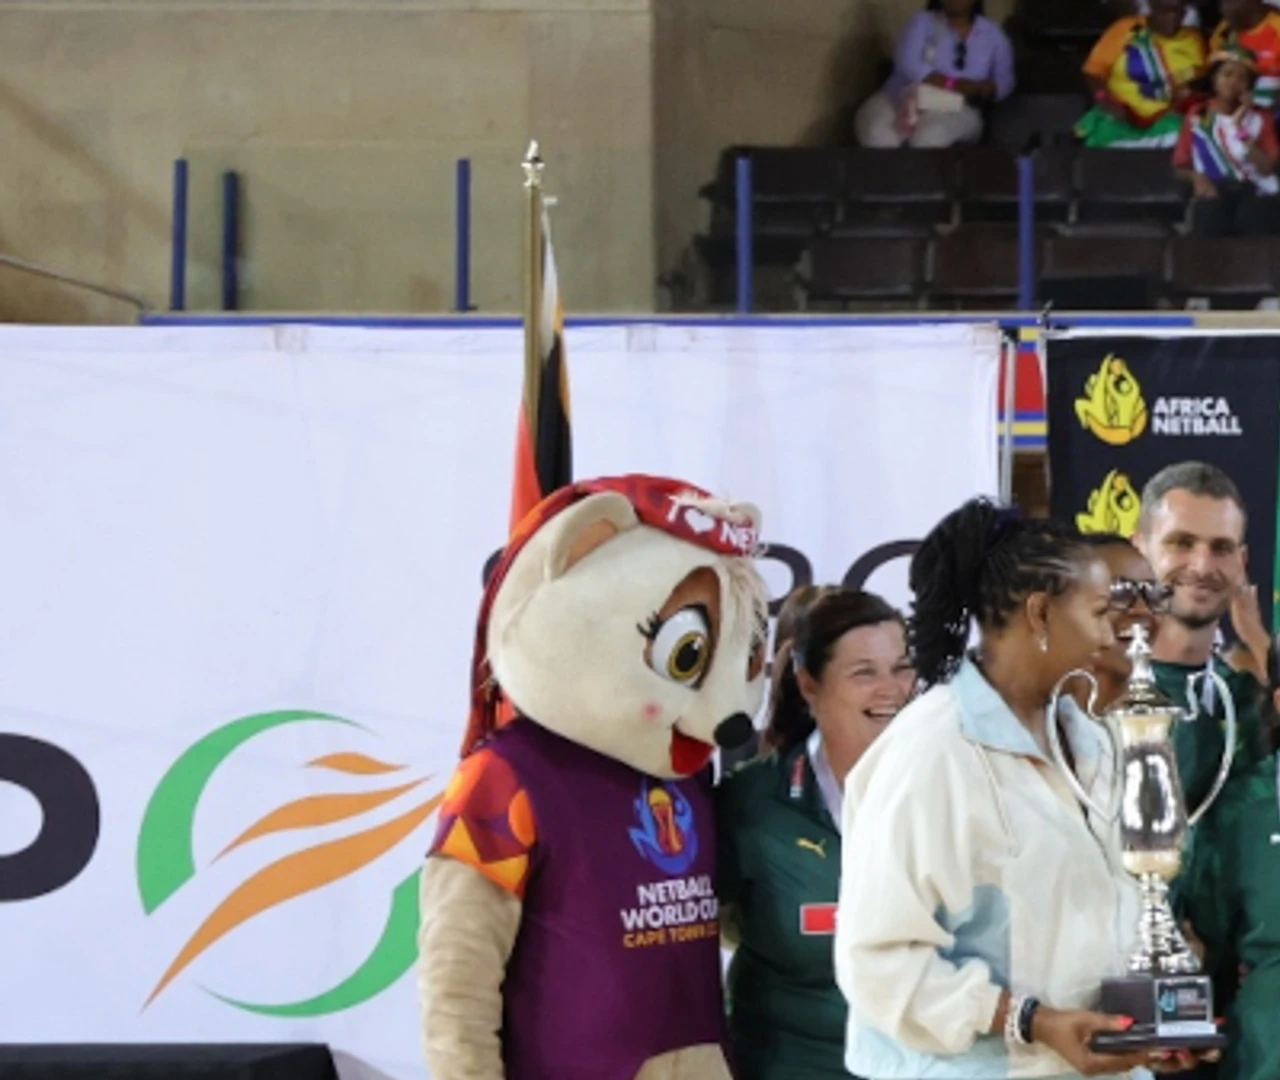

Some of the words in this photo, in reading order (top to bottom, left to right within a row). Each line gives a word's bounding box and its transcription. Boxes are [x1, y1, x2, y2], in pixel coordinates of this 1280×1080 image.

[1154, 397, 1230, 416] AFRICA
[1152, 415, 1242, 435] NETBALL
[636, 874, 715, 906] NETBALL
[620, 901, 698, 931] WORLD
[700, 897, 719, 921] CU
[623, 929, 667, 949] CAPE
